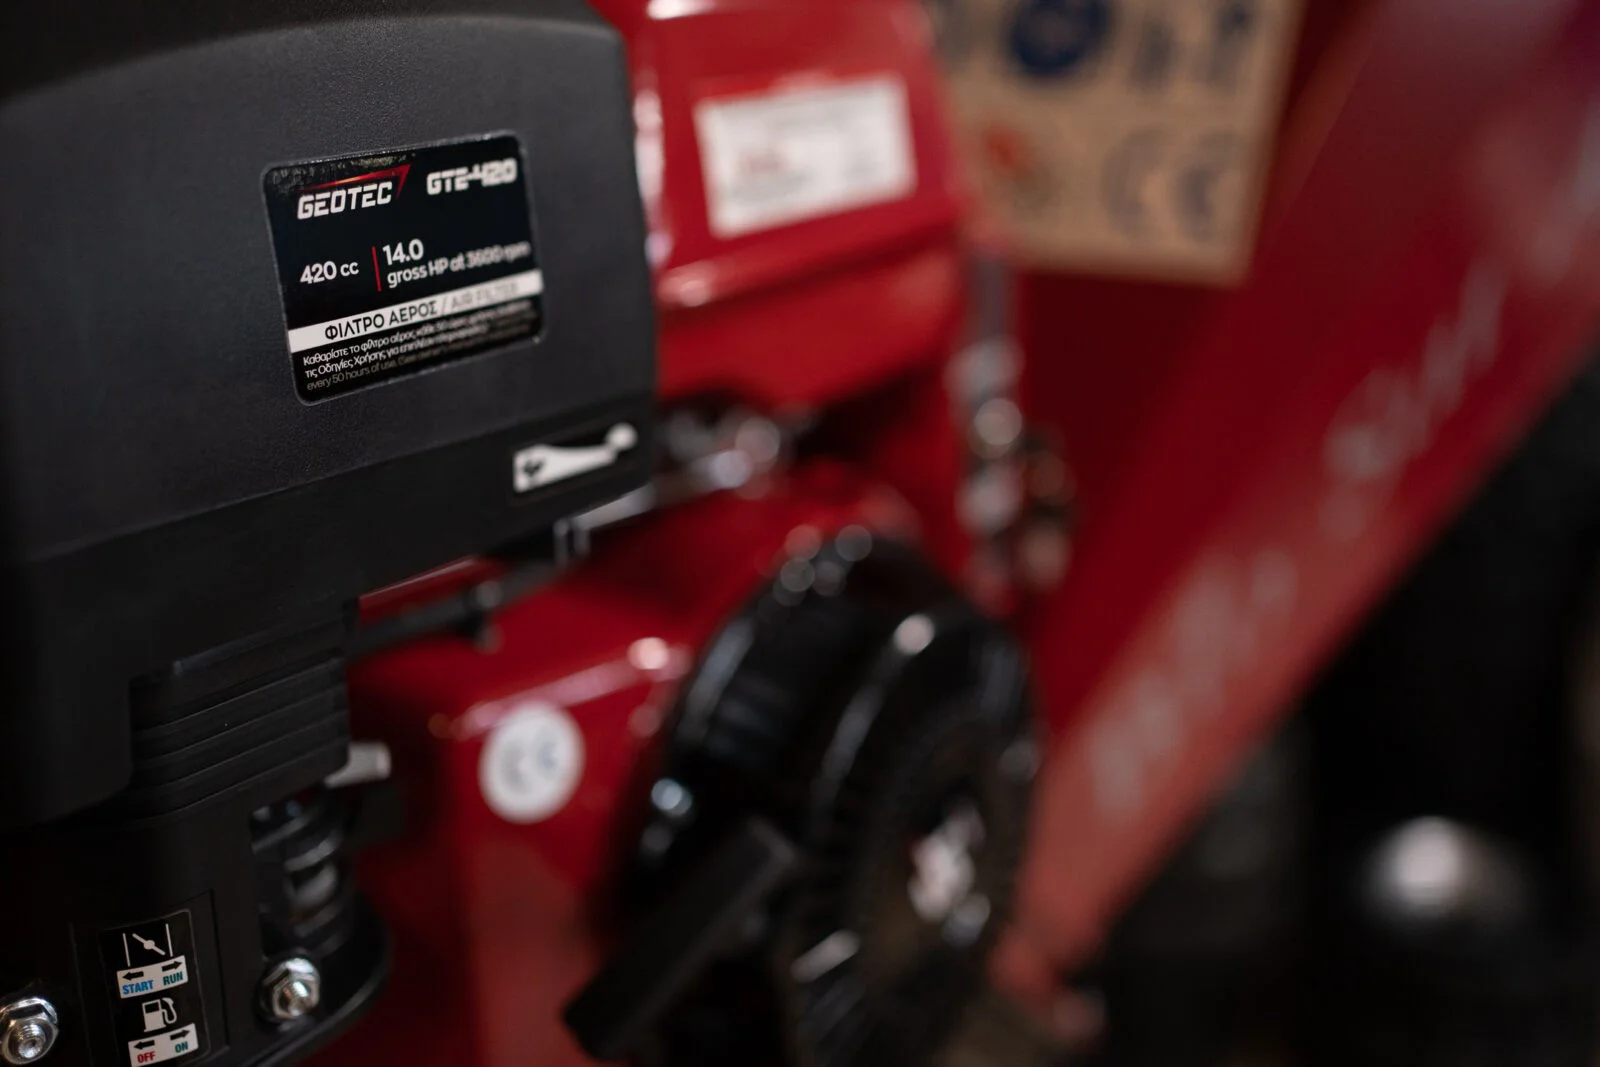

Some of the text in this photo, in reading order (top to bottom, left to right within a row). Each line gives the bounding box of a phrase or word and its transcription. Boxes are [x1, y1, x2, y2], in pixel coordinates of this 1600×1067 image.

[427, 158, 517, 195] GTE-420
[297, 181, 392, 219] GEOTEC
[382, 239, 424, 265] 14.0
[300, 261, 359, 284] 420 cc
[387, 264, 427, 288] gross
[428, 257, 448, 276] HP
[450, 252, 465, 272] at
[325, 314, 384, 340] ΦΙΛΤΡΟ
[389, 301, 437, 326] ΑΕΡΟΣ
[303, 347, 349, 366] Καθαρίστε
[350, 344, 360, 354] το
[304, 369, 318, 378] τις
[306, 376, 332, 391] every
[332, 372, 345, 384] 50
[345, 366, 370, 381] hours
[122, 971, 184, 995] START RUN
[137, 1041, 189, 1064] OFF ON
